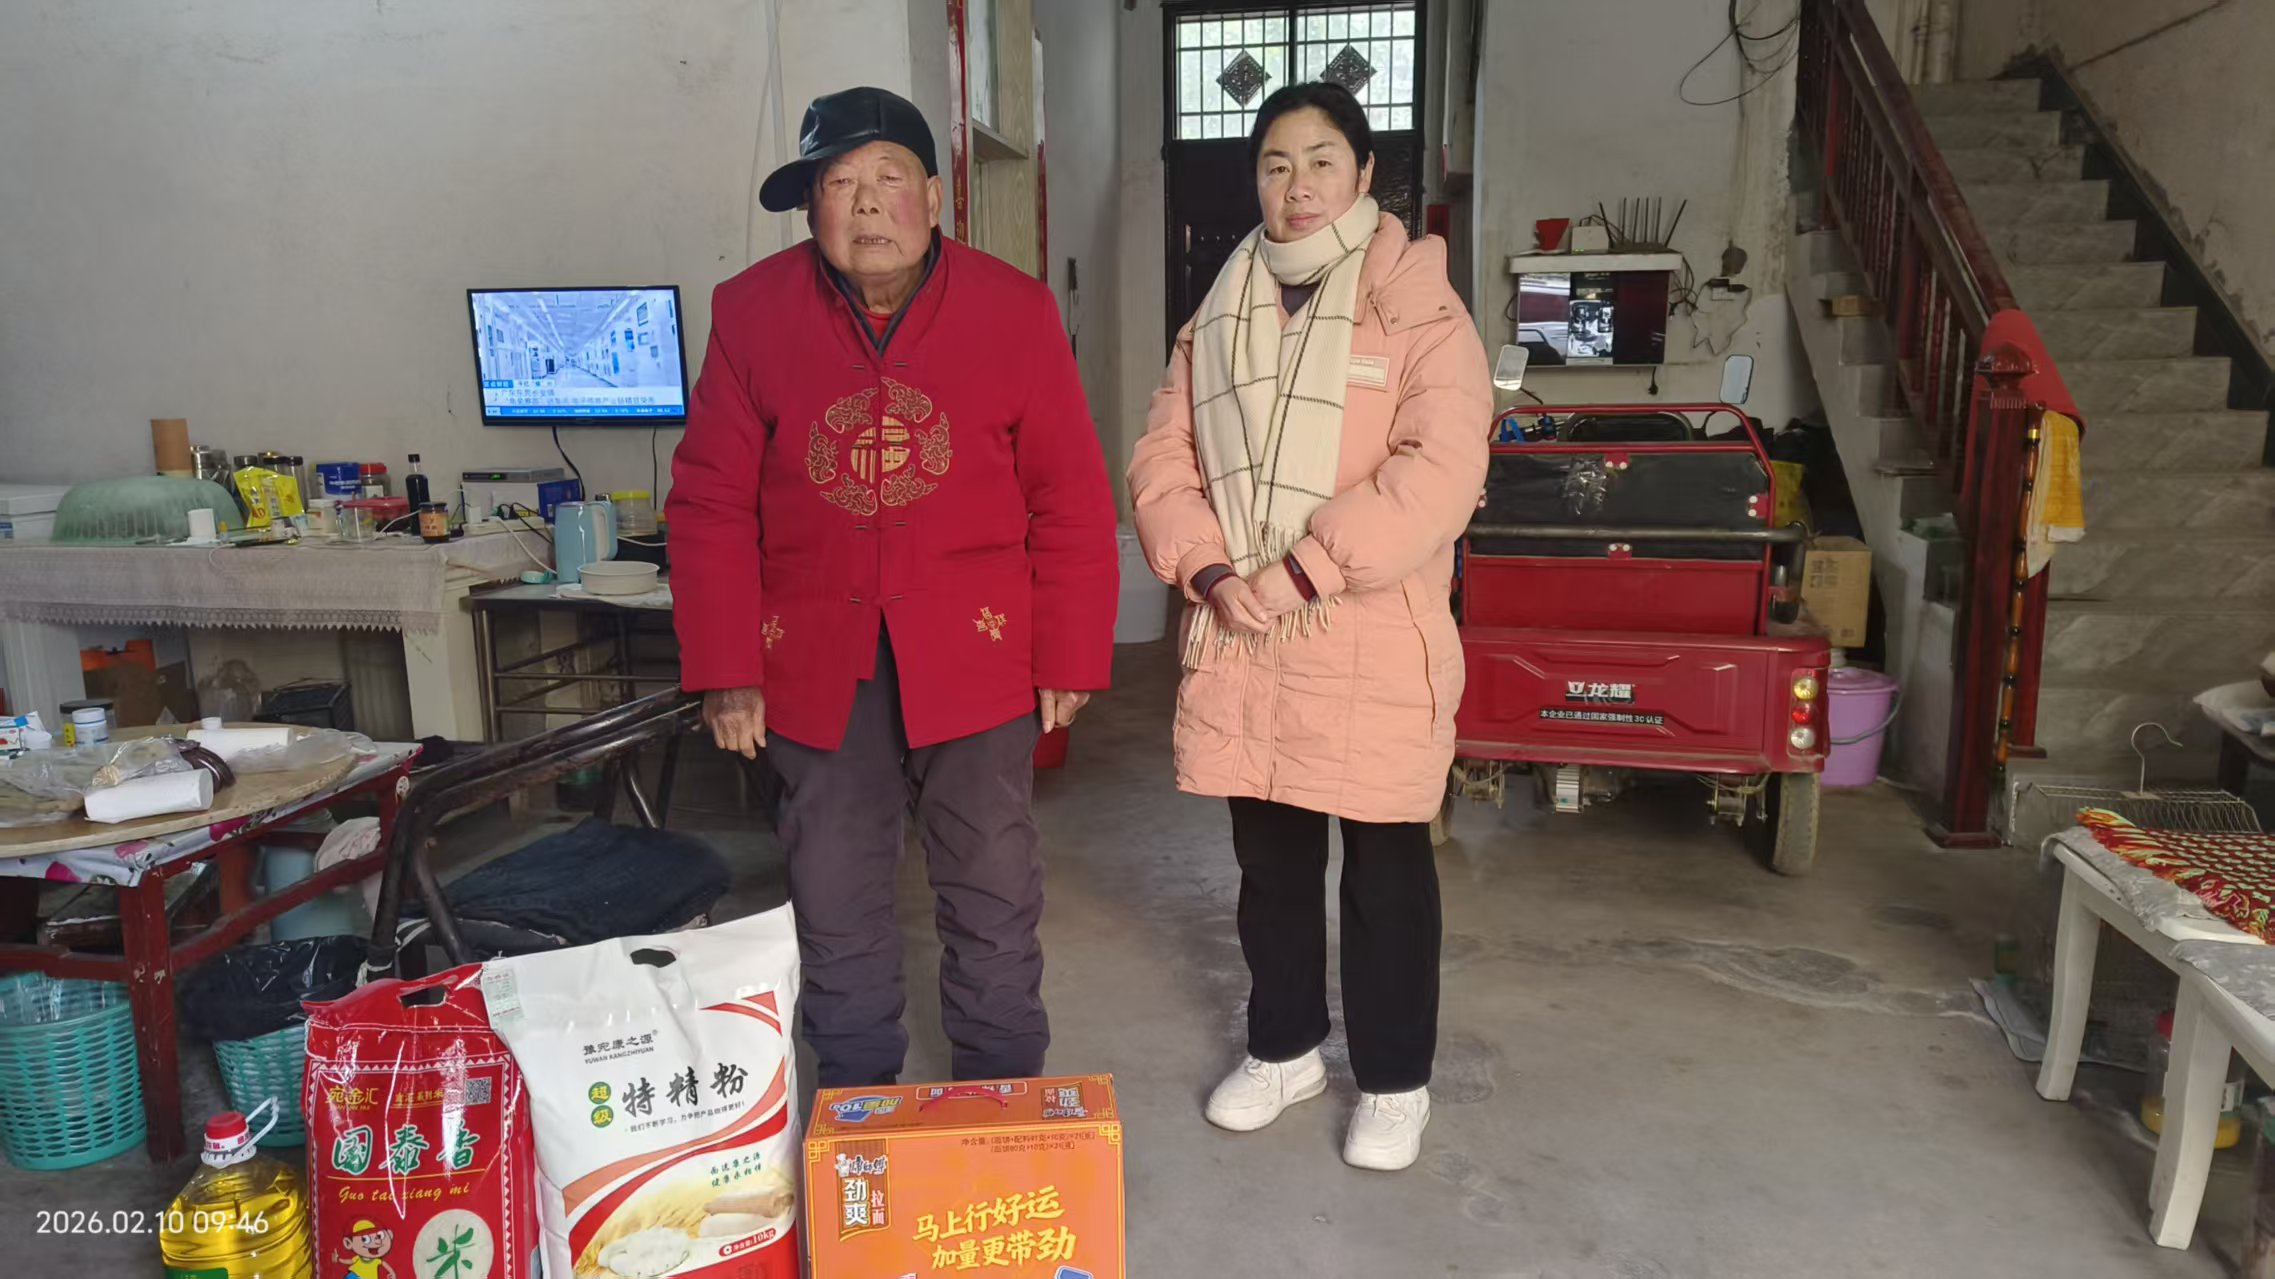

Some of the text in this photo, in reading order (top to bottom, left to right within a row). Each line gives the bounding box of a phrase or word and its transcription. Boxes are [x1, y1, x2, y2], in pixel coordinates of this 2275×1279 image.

[590, 1084, 613, 1126] 超级
[622, 1062, 748, 1118] 特精粉
[339, 1186, 364, 1203] Guo
[449, 1182, 470, 1195] mi
[843, 1177, 869, 1226] 劲爽
[871, 1189, 885, 1225] 拉面
[912, 1185, 1065, 1242] 马上行好运
[426, 1224, 475, 1279] 米
[931, 1226, 1077, 1271] 加量更带劲
